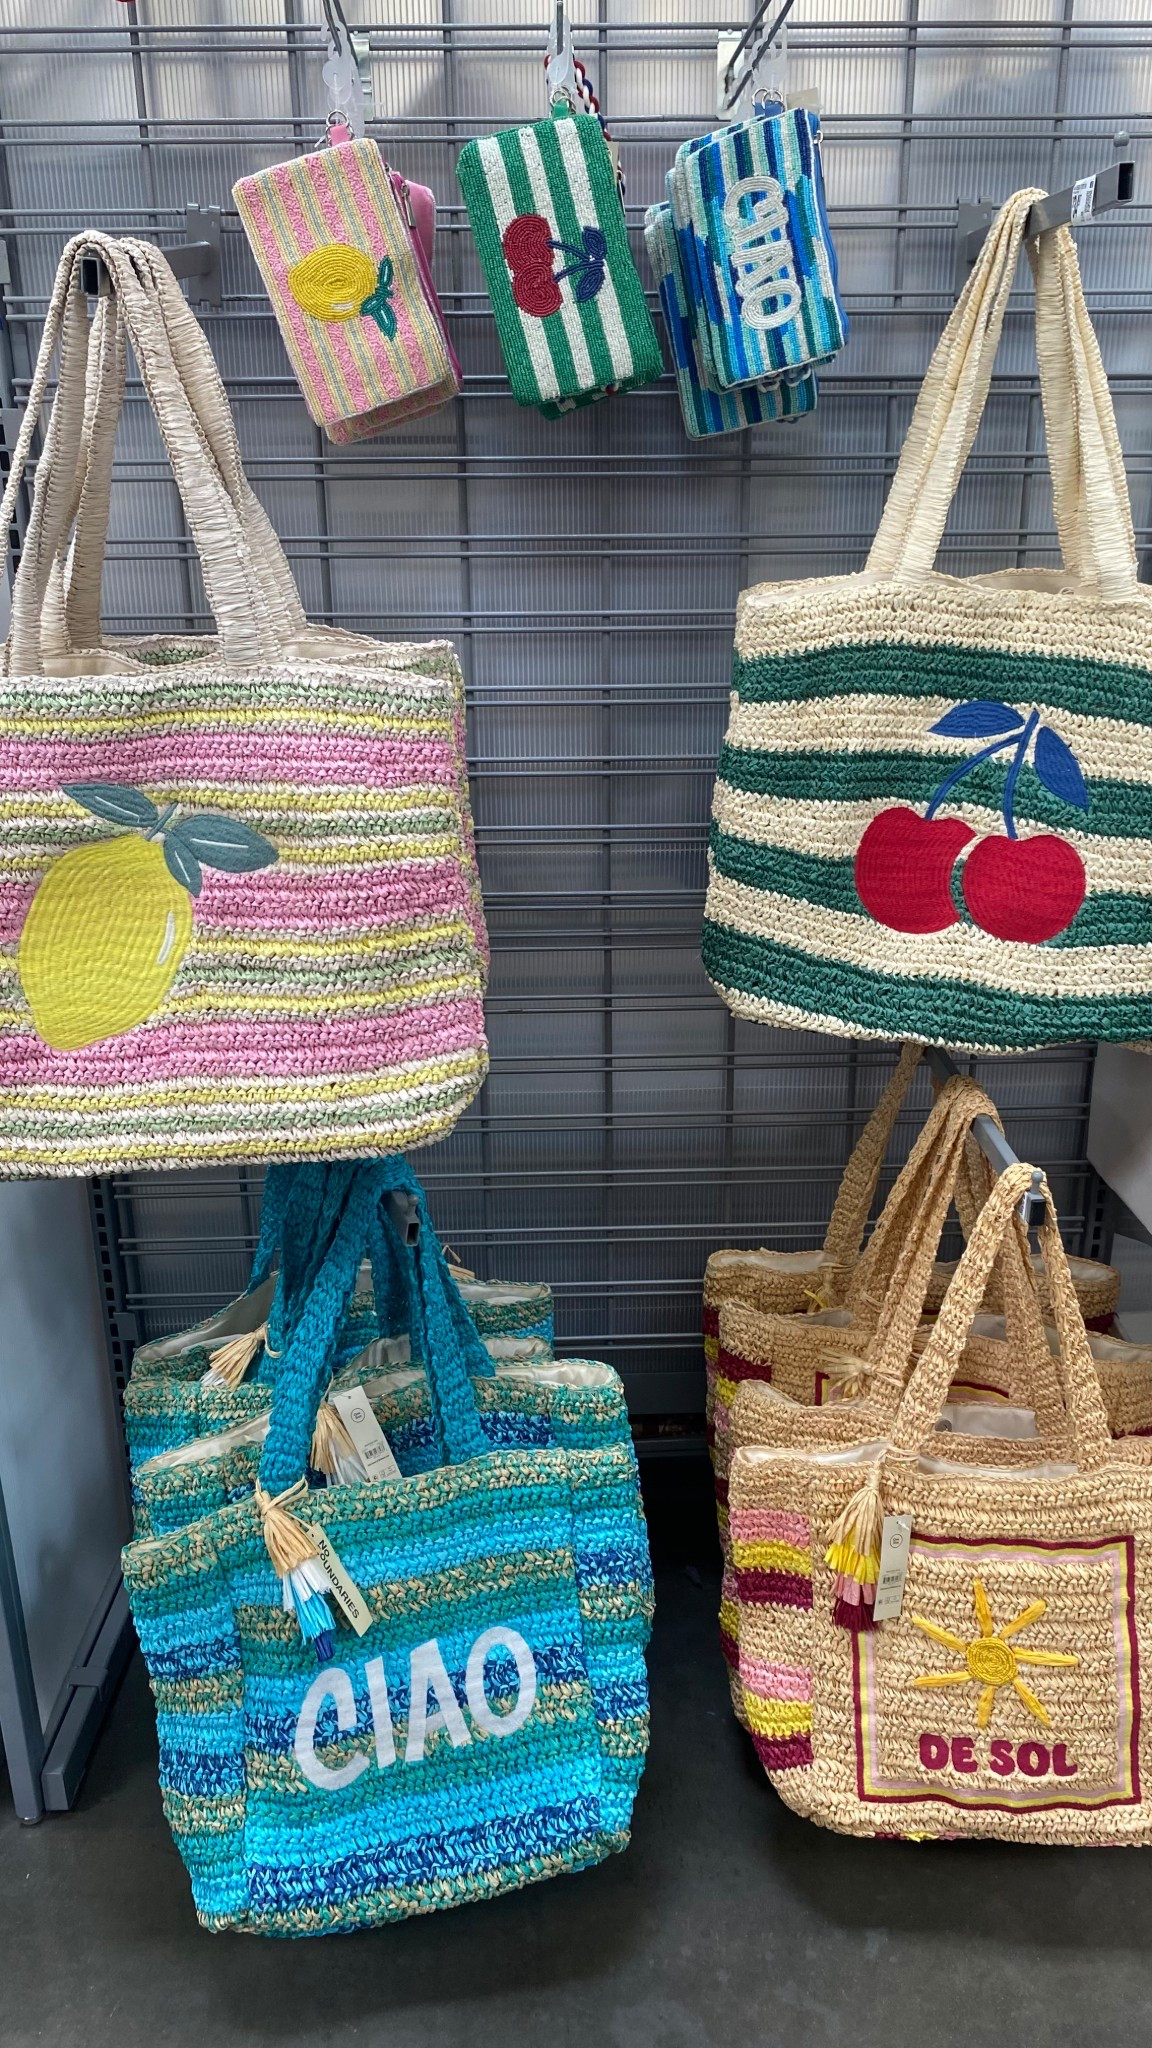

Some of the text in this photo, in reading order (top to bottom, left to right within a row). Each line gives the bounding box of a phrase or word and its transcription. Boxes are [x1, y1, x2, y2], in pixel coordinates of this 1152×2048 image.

[724, 175, 801, 330] CIAO
[318, 1540, 330, 1557] NO
[318, 1551, 360, 1619] OUNDARIES
[294, 1625, 536, 1791] CIAO
[919, 1733, 1078, 1777] DE SOL
